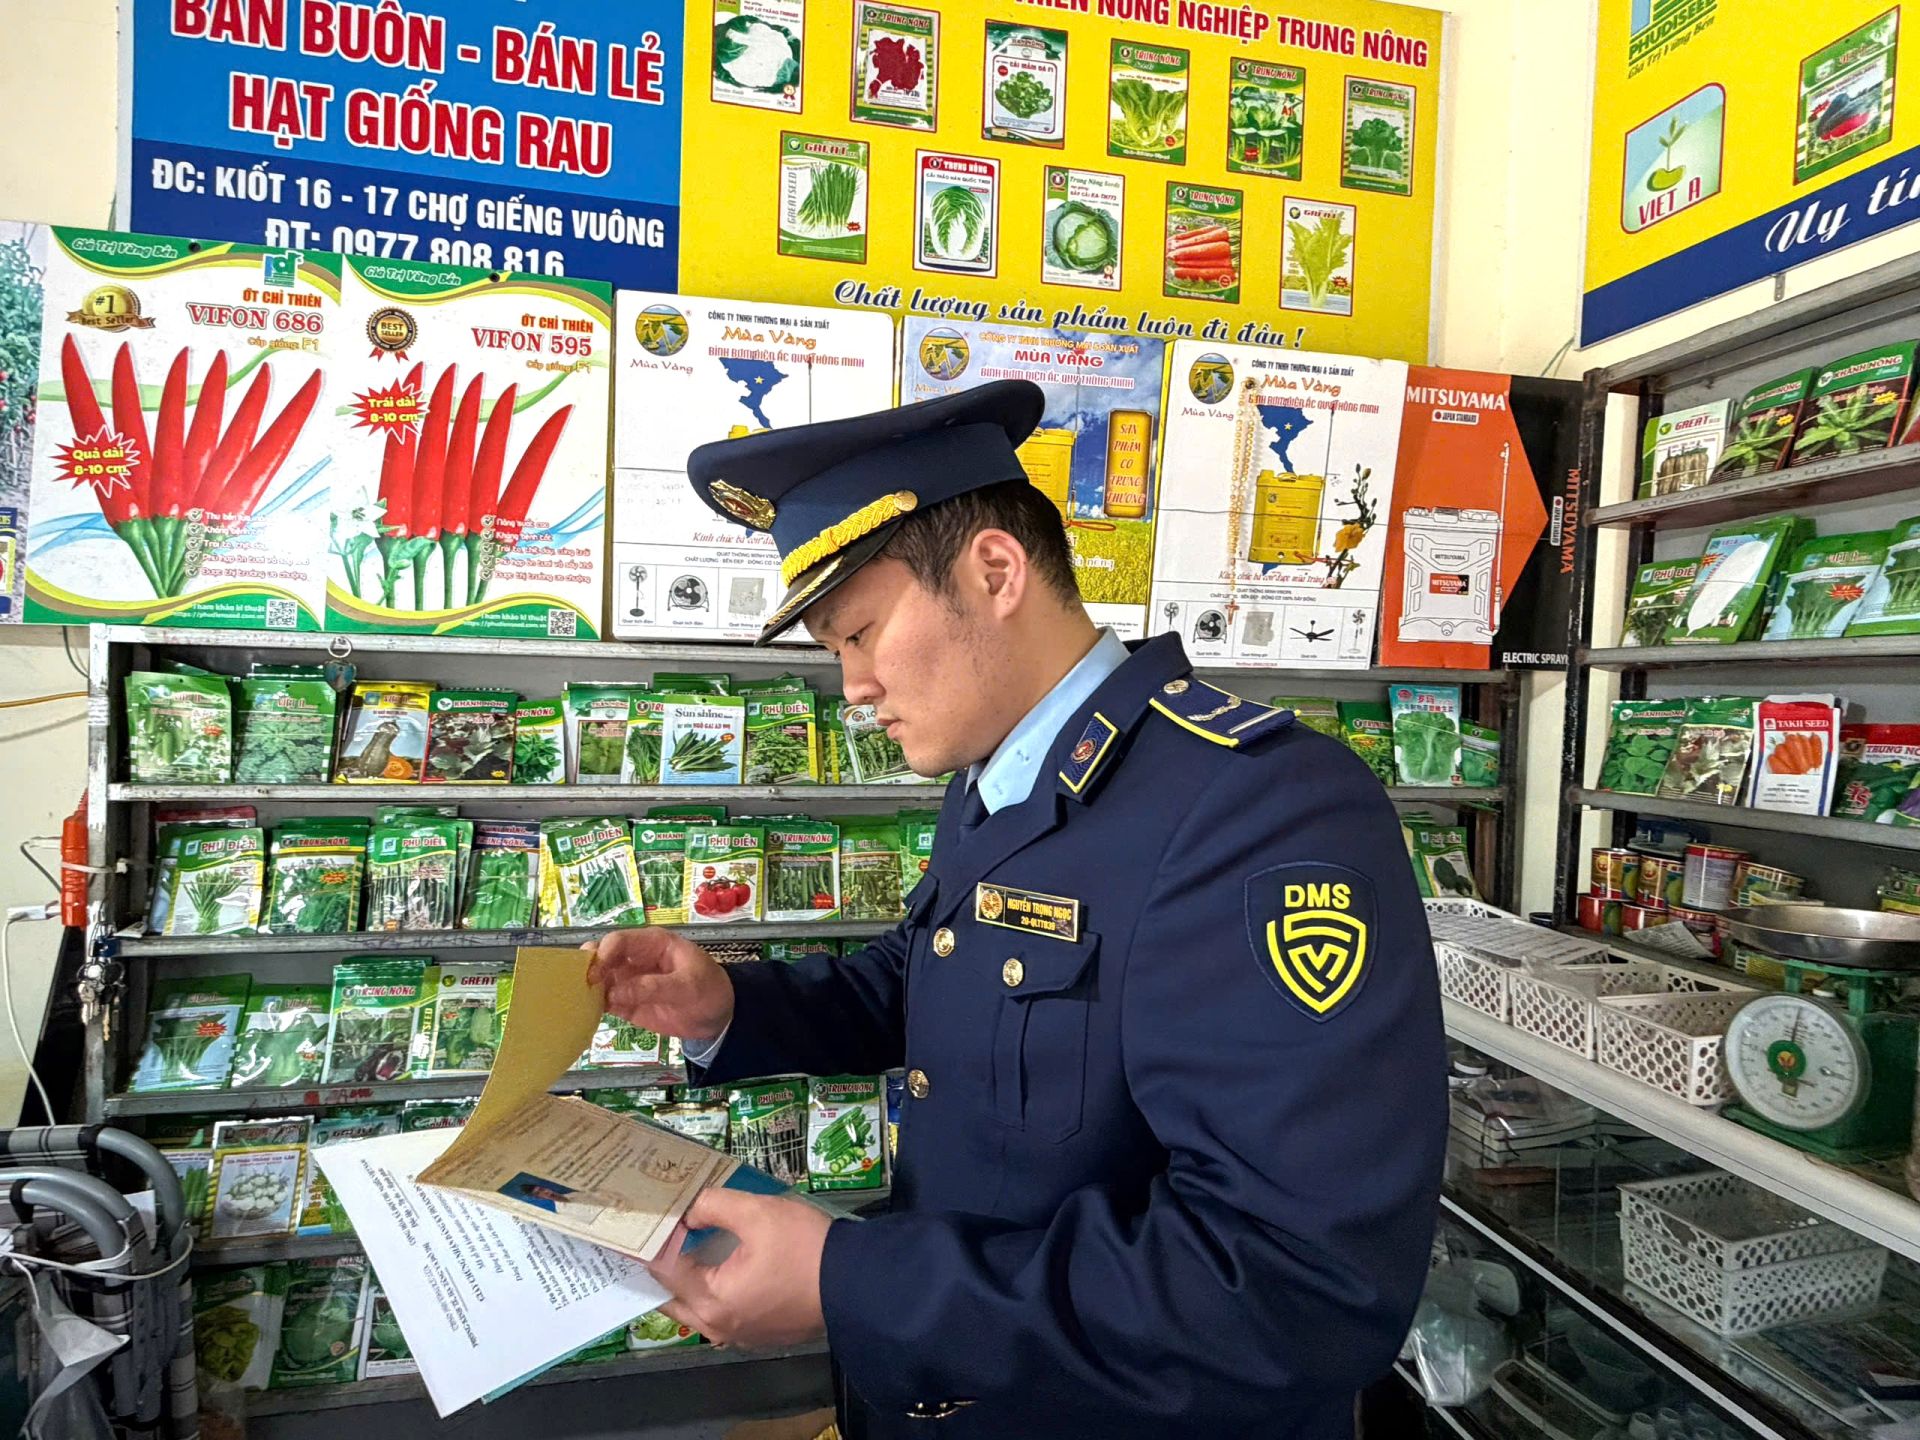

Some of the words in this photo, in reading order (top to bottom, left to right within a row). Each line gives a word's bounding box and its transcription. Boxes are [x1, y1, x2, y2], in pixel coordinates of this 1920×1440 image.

[1178, 0, 1268, 44] NGHIỆP
[1278, 16, 1355, 56] TRUNG
[1363, 29, 1427, 67] NÔNG
[301, 0, 444, 73] BUÔN
[458, 45, 480, 62] -
[493, 21, 597, 96] BÁN
[608, 31, 665, 105] LẺ
[229, 71, 334, 150] HẠT
[345, 80, 504, 166] GIỐNG
[517, 112, 612, 180] RAU
[943, 157, 967, 171] TRUNG
[152, 158, 205, 194] ĐC:
[215, 161, 286, 204] KIỐT
[296, 177, 332, 209] 16
[341, 195, 353, 203] -
[364, 185, 399, 217] 17
[408, 190, 469, 231] CHỢ
[476, 194, 564, 237] GIẾNG
[571, 208, 665, 248] VUÔNG
[265, 218, 321, 250] ĐT:
[333, 226, 419, 261] 0977
[187, 302, 269, 329] VIFON
[274, 310, 323, 334] 686
[708, 311, 726, 321] CÔNG
[727, 313, 734, 322] TY
[753, 315, 779, 326] THƯƠNG
[800, 316, 812, 328] SẢN
[833, 280, 902, 308] Chất
[910, 288, 990, 323] lượng
[998, 296, 1044, 323] sản
[1053, 305, 1128, 331] phẩm
[1137, 312, 1194, 336] luôn
[1201, 318, 1229, 341] đi
[1237, 320, 1296, 347] đầu
[1293, 327, 1305, 348] !
[381, 322, 404, 331] BEST
[471, 326, 543, 352] VIFON
[550, 334, 592, 356] 595
[721, 325, 765, 343] Mùa
[768, 329, 817, 350] Vàng
[1014, 349, 1051, 363] MÙA
[1056, 350, 1104, 368] VÀNG
[630, 358, 658, 370] Mùa
[662, 361, 694, 374] Vàng
[1261, 373, 1297, 390] Mùa
[1302, 377, 1341, 397] Vàng
[368, 396, 394, 408] Trái
[396, 396, 416, 407] dài
[1406, 385, 1507, 411] MITSUYAMA
[370, 412, 397, 423] 8-10
[399, 413, 418, 422] cm
[1181, 407, 1206, 418] Mùa
[1208, 409, 1234, 421] Vàng
[1442, 412, 1456, 422] JAPAN
[1675, 415, 1709, 430] GREAT
[72, 448, 100, 460] Quả
[102, 445, 124, 459] dài
[74, 464, 105, 476] 8-10
[105, 465, 128, 474] cm
[1560, 468, 1580, 574] MITSUYAMA
[1653, 568, 1675, 580] PHÚ
[1431, 578, 1468, 588] MITSUYAMA
[1502, 652, 1540, 664] ELECTRIC
[761, 701, 783, 714] PHÚ
[785, 699, 809, 713] ĐIỀN
[1776, 719, 1804, 728] TAKII
[1804, 720, 1830, 728] SEED
[1866, 745, 1903, 755] TRUNG
[298, 837, 325, 847] TRUNG
[326, 836, 349, 846] NÔNG
[402, 836, 421, 847] PHÚ
[572, 833, 595, 847] PHÚ
[597, 825, 624, 841] ĐIỀN
[657, 831, 685, 840] KHÁNH
[709, 834, 730, 846] PHÚ
[732, 834, 758, 847] ĐIỀN
[782, 833, 810, 843] TRUNG
[811, 832, 833, 844] NÔNG
[201, 838, 225, 851] PHÚ
[1284, 883, 1351, 909] DMS
[460, 975, 497, 986] GREAT
[827, 1082, 852, 1093] TRUNG
